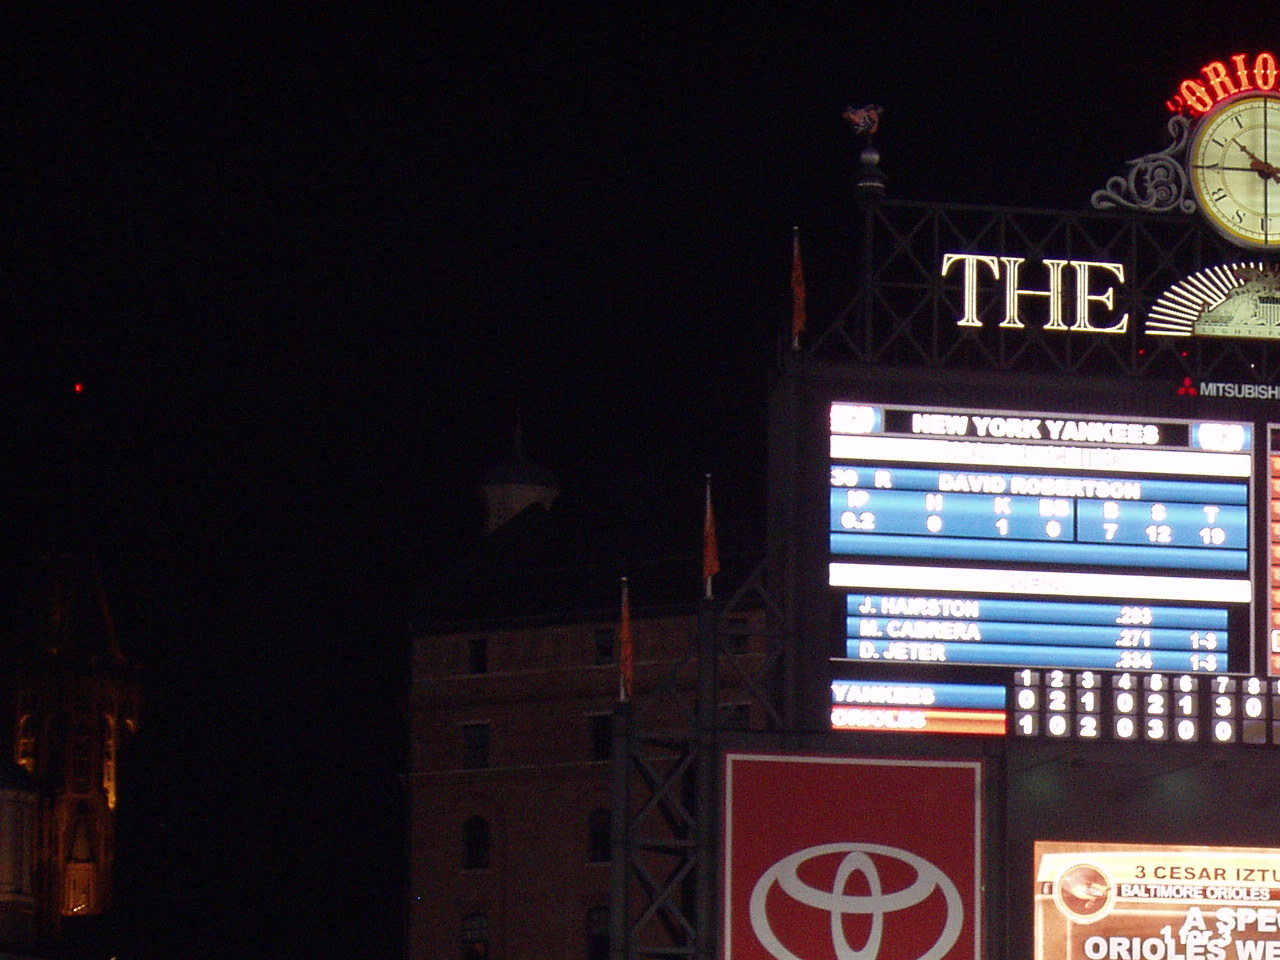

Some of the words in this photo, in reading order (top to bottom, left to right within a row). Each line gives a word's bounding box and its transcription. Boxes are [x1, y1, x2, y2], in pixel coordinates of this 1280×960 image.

[942, 252, 1129, 334] THE
[912, 413, 968, 435] NEW
[971, 416, 1041, 439] YORK
[1045, 420, 1160, 444] YANKEES
[874, 470, 892, 488] R
[938, 473, 1007, 493] DAVID
[1010, 476, 1141, 499] ROBERTSON
[994, 496, 1011, 514] K
[1203, 506, 1220, 523] T
[996, 518, 1008, 535] 1
[1103, 523, 1119, 540] 7
[1145, 525, 1172, 542] 12
[858, 596, 876, 614] J.
[881, 597, 979, 618] HAIRSTON
[859, 619, 883, 637] M.
[886, 620, 981, 641] CABRERA
[1116, 629, 1151, 647] .271
[1190, 632, 1217, 650] 1-3
[859, 641, 879, 659] D.
[883, 642, 947, 661] JETER
[1021, 669, 1031, 686] 1
[1050, 670, 1064, 688] 2
[1081, 671, 1094, 689] 3
[1118, 673, 1131, 690] 4
[1217, 676, 1229, 693] 7
[831, 684, 935, 705] YANKEES
[1018, 690, 1035, 709] 0
[1049, 690, 1066, 711] 2
[1081, 692, 1094, 711] 1
[1116, 693, 1134, 713] 0
[1147, 694, 1164, 714] 2
[1179, 695, 1192, 715] 1
[1215, 696, 1231, 716] 3
[1246, 697, 1263, 718] 0
[831, 709, 927, 729] ORIOLES
[1019, 715, 1033, 735] 1
[1049, 715, 1066, 735] 0
[1080, 716, 1097, 736] 2
[1116, 718, 1134, 738] 0
[1147, 719, 1164, 739] 3
[1178, 720, 1195, 740] 0
[1215, 721, 1232, 741] 0
[1135, 865, 1146, 879] 3
[1154, 866, 1227, 881] CESAR
[1121, 884, 1204, 899] BALTIMORE
[1206, 887, 1271, 901] ORIOLES
[1183, 906, 1206, 931] A
